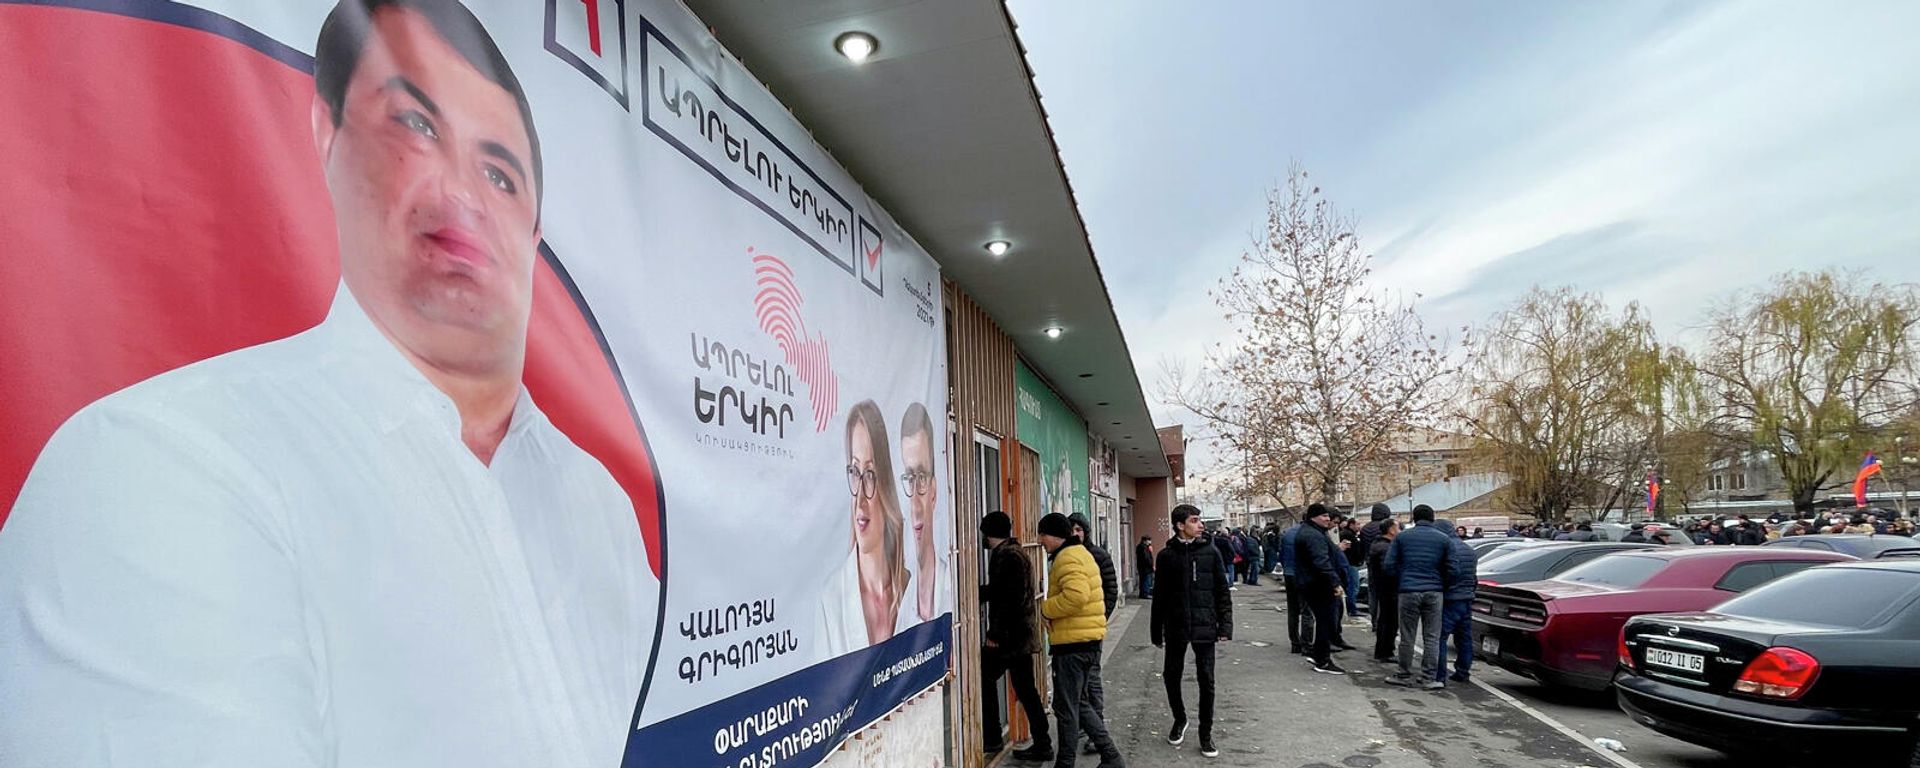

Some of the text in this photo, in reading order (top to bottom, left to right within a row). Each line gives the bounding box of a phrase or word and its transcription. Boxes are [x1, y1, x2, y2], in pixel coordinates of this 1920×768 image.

[659, 65, 848, 242] ԱՊՐԵԼՈՒ ԵՐԿԻՐ
[695, 376, 794, 439] ԵՐԿԻՐ
[680, 598, 774, 640] ՎԱԼՈԴՅԱ
[678, 629, 798, 684] ԳՐԻԳՈՐՅԱՆ
[1691, 656, 1702, 670] 05
[715, 696, 808, 754] ՓԱՐԱՔԱՐԻ
